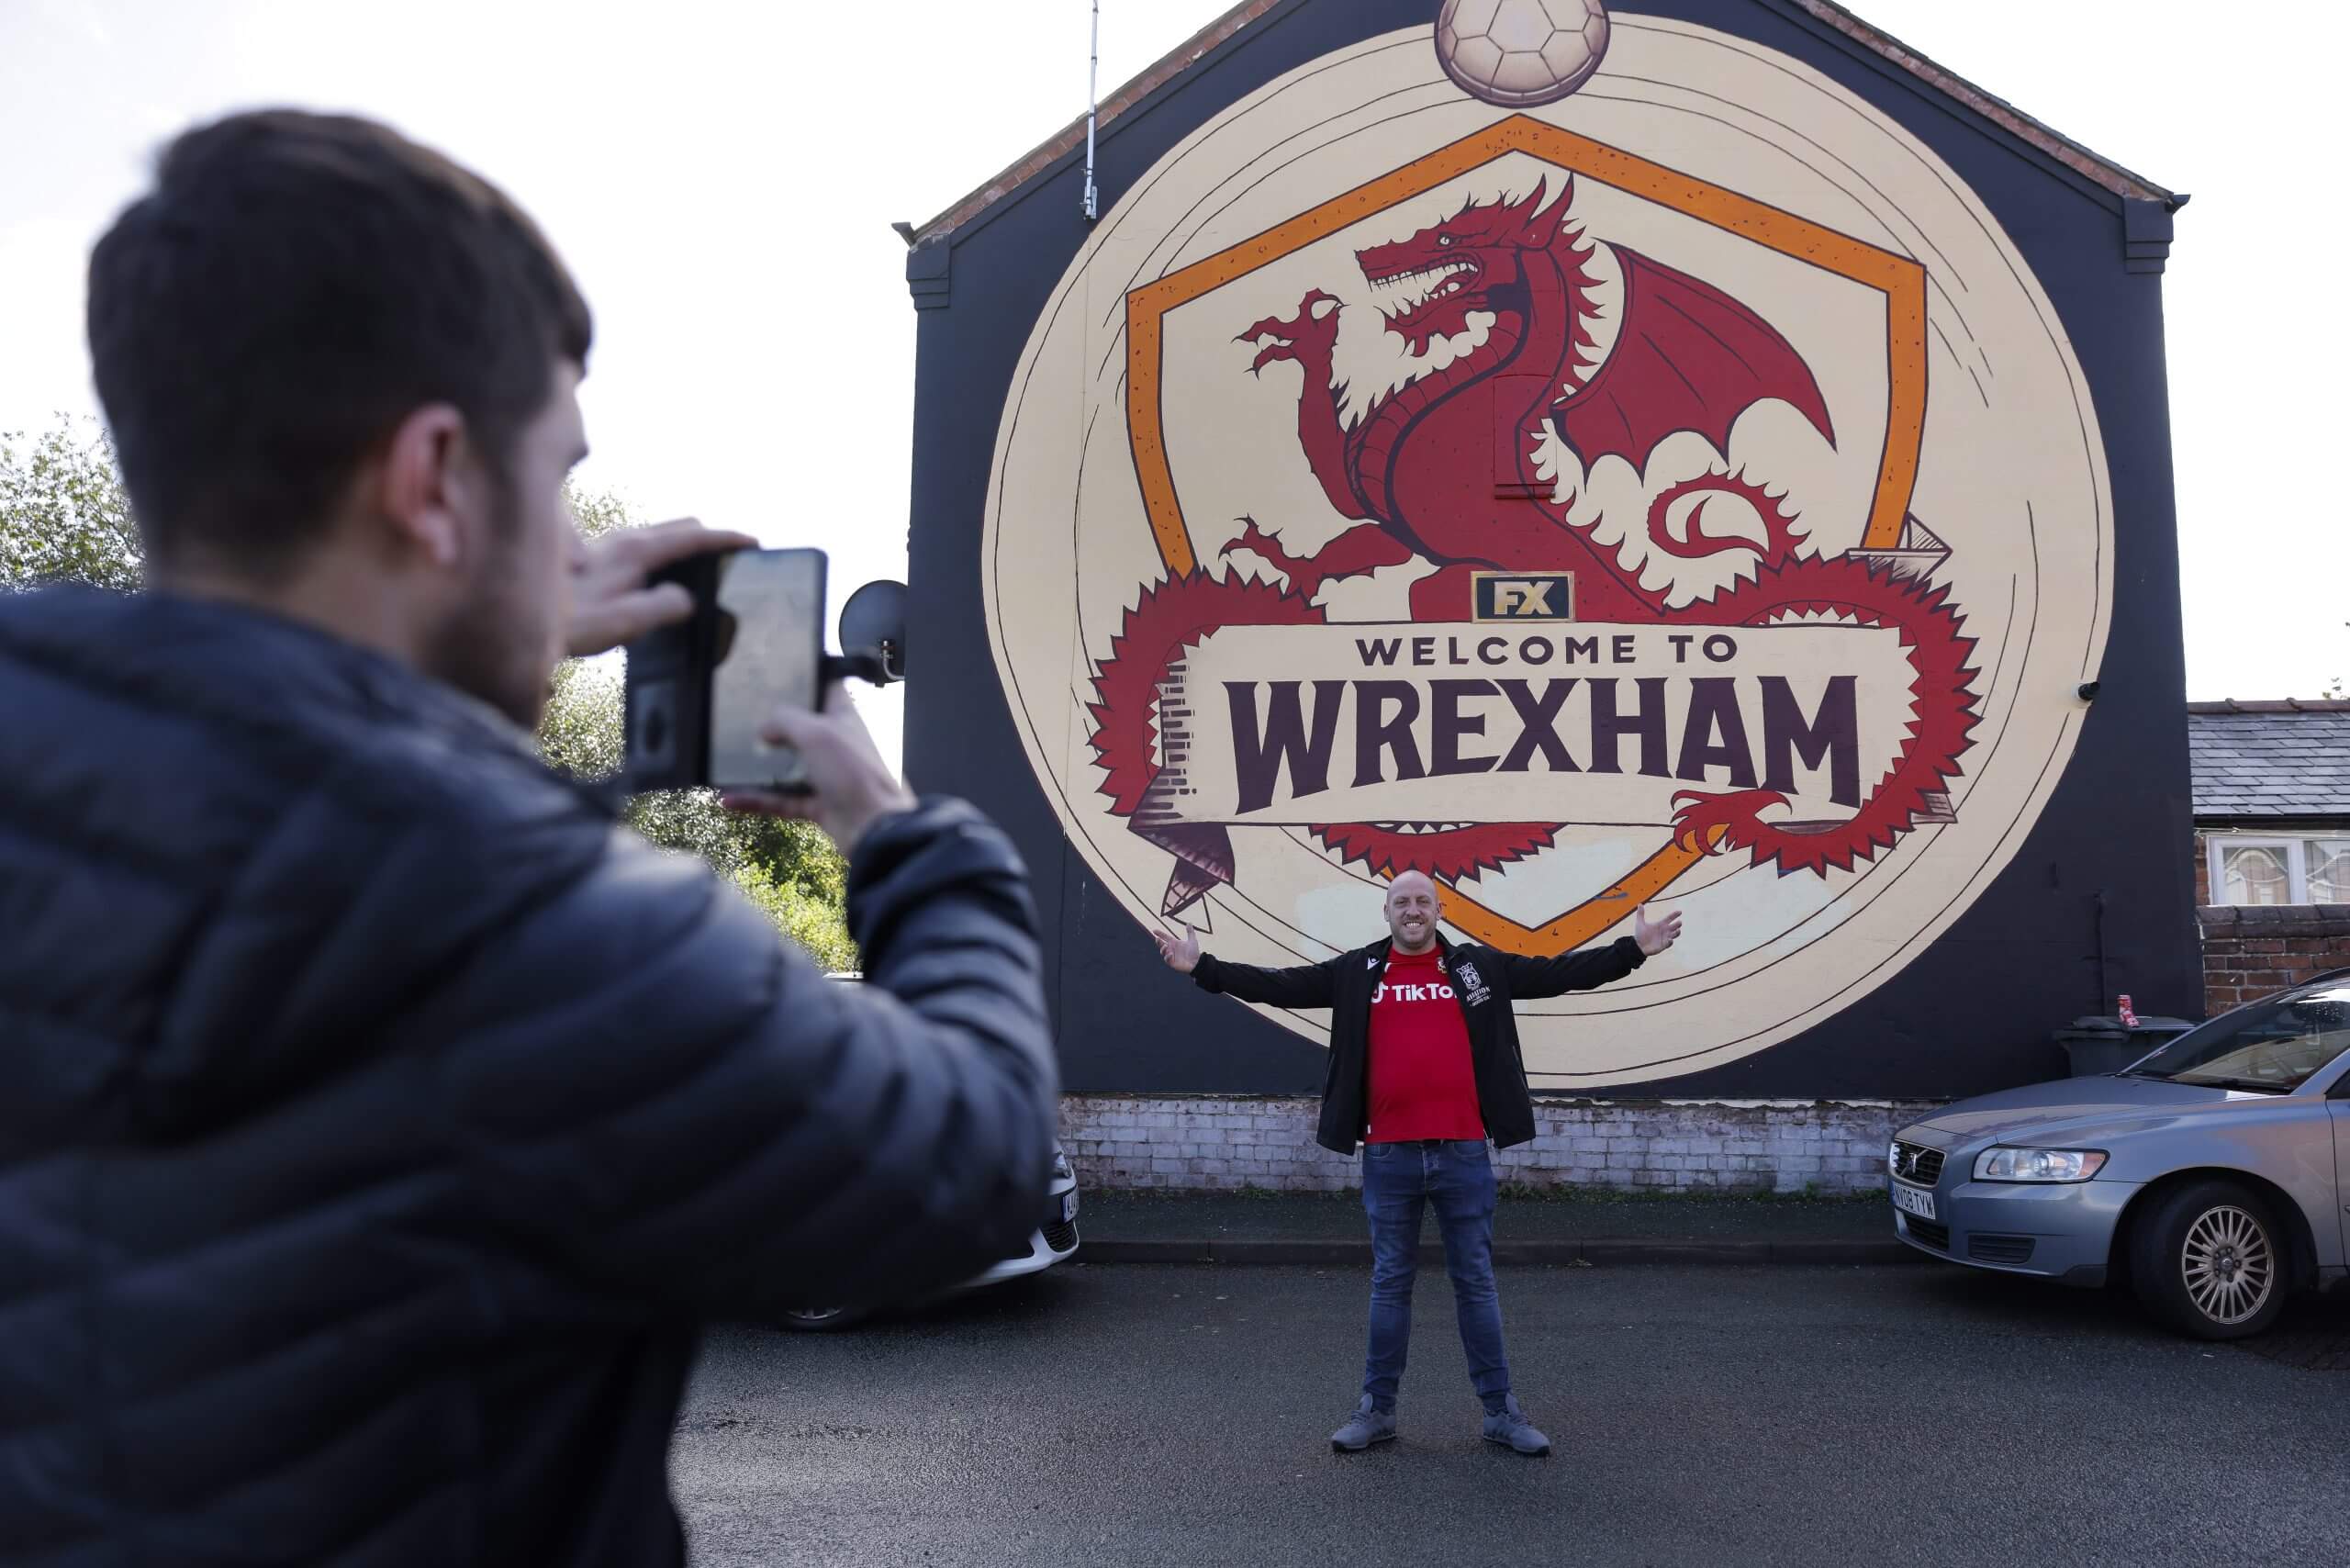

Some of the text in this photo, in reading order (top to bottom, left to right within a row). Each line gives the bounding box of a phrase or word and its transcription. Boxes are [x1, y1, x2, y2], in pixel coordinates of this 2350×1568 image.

[1494, 580, 1555, 615] FX
[1355, 633, 1738, 666] WELCOME TO
[1221, 675, 1861, 816] WREXHAM
[1391, 982, 1458, 1002] TikTo
